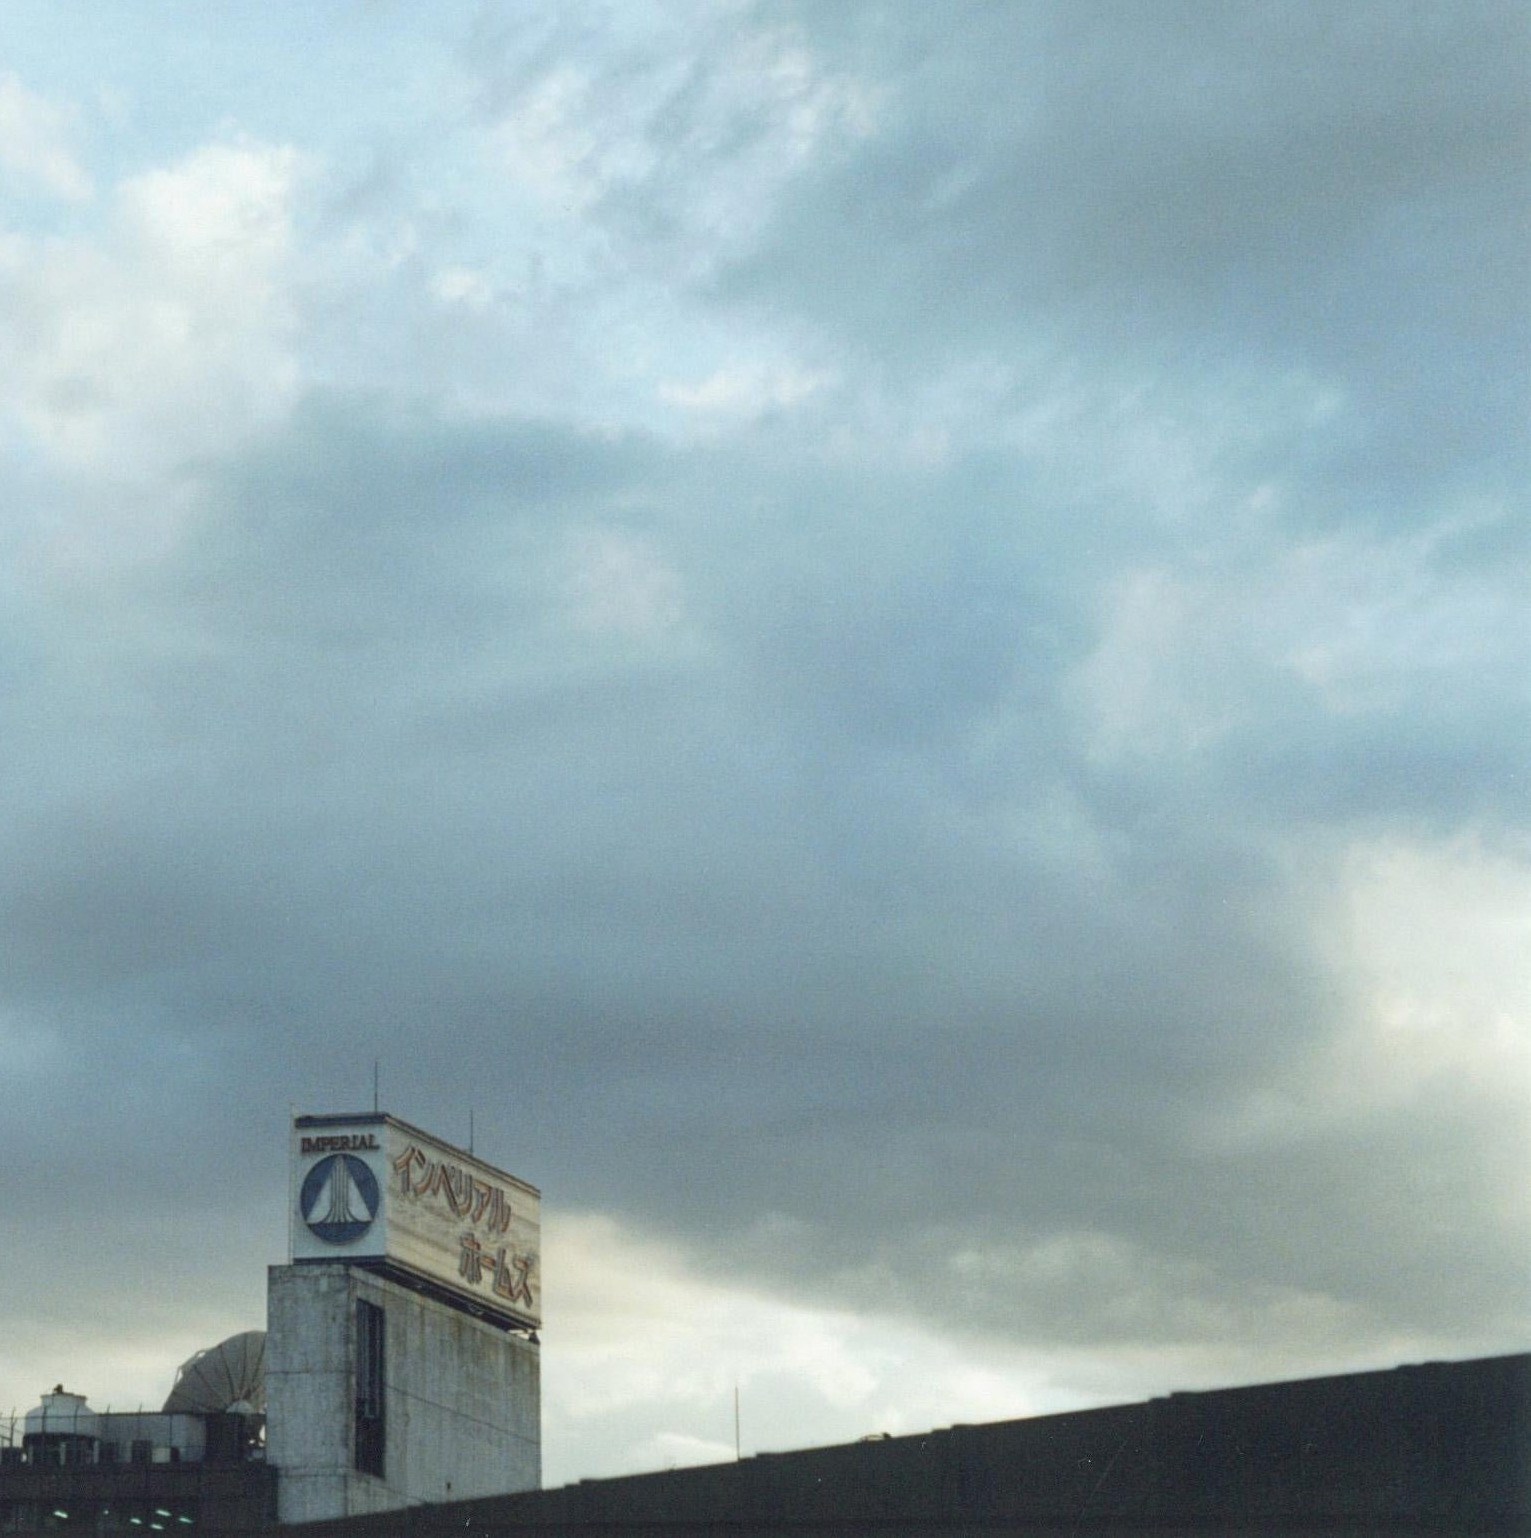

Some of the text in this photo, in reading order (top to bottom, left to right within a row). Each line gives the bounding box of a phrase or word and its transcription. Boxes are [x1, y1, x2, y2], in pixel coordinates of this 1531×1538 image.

[301, 1134, 380, 1153] IMPERIAL
[393, 1146, 512, 1233] インペリアル
